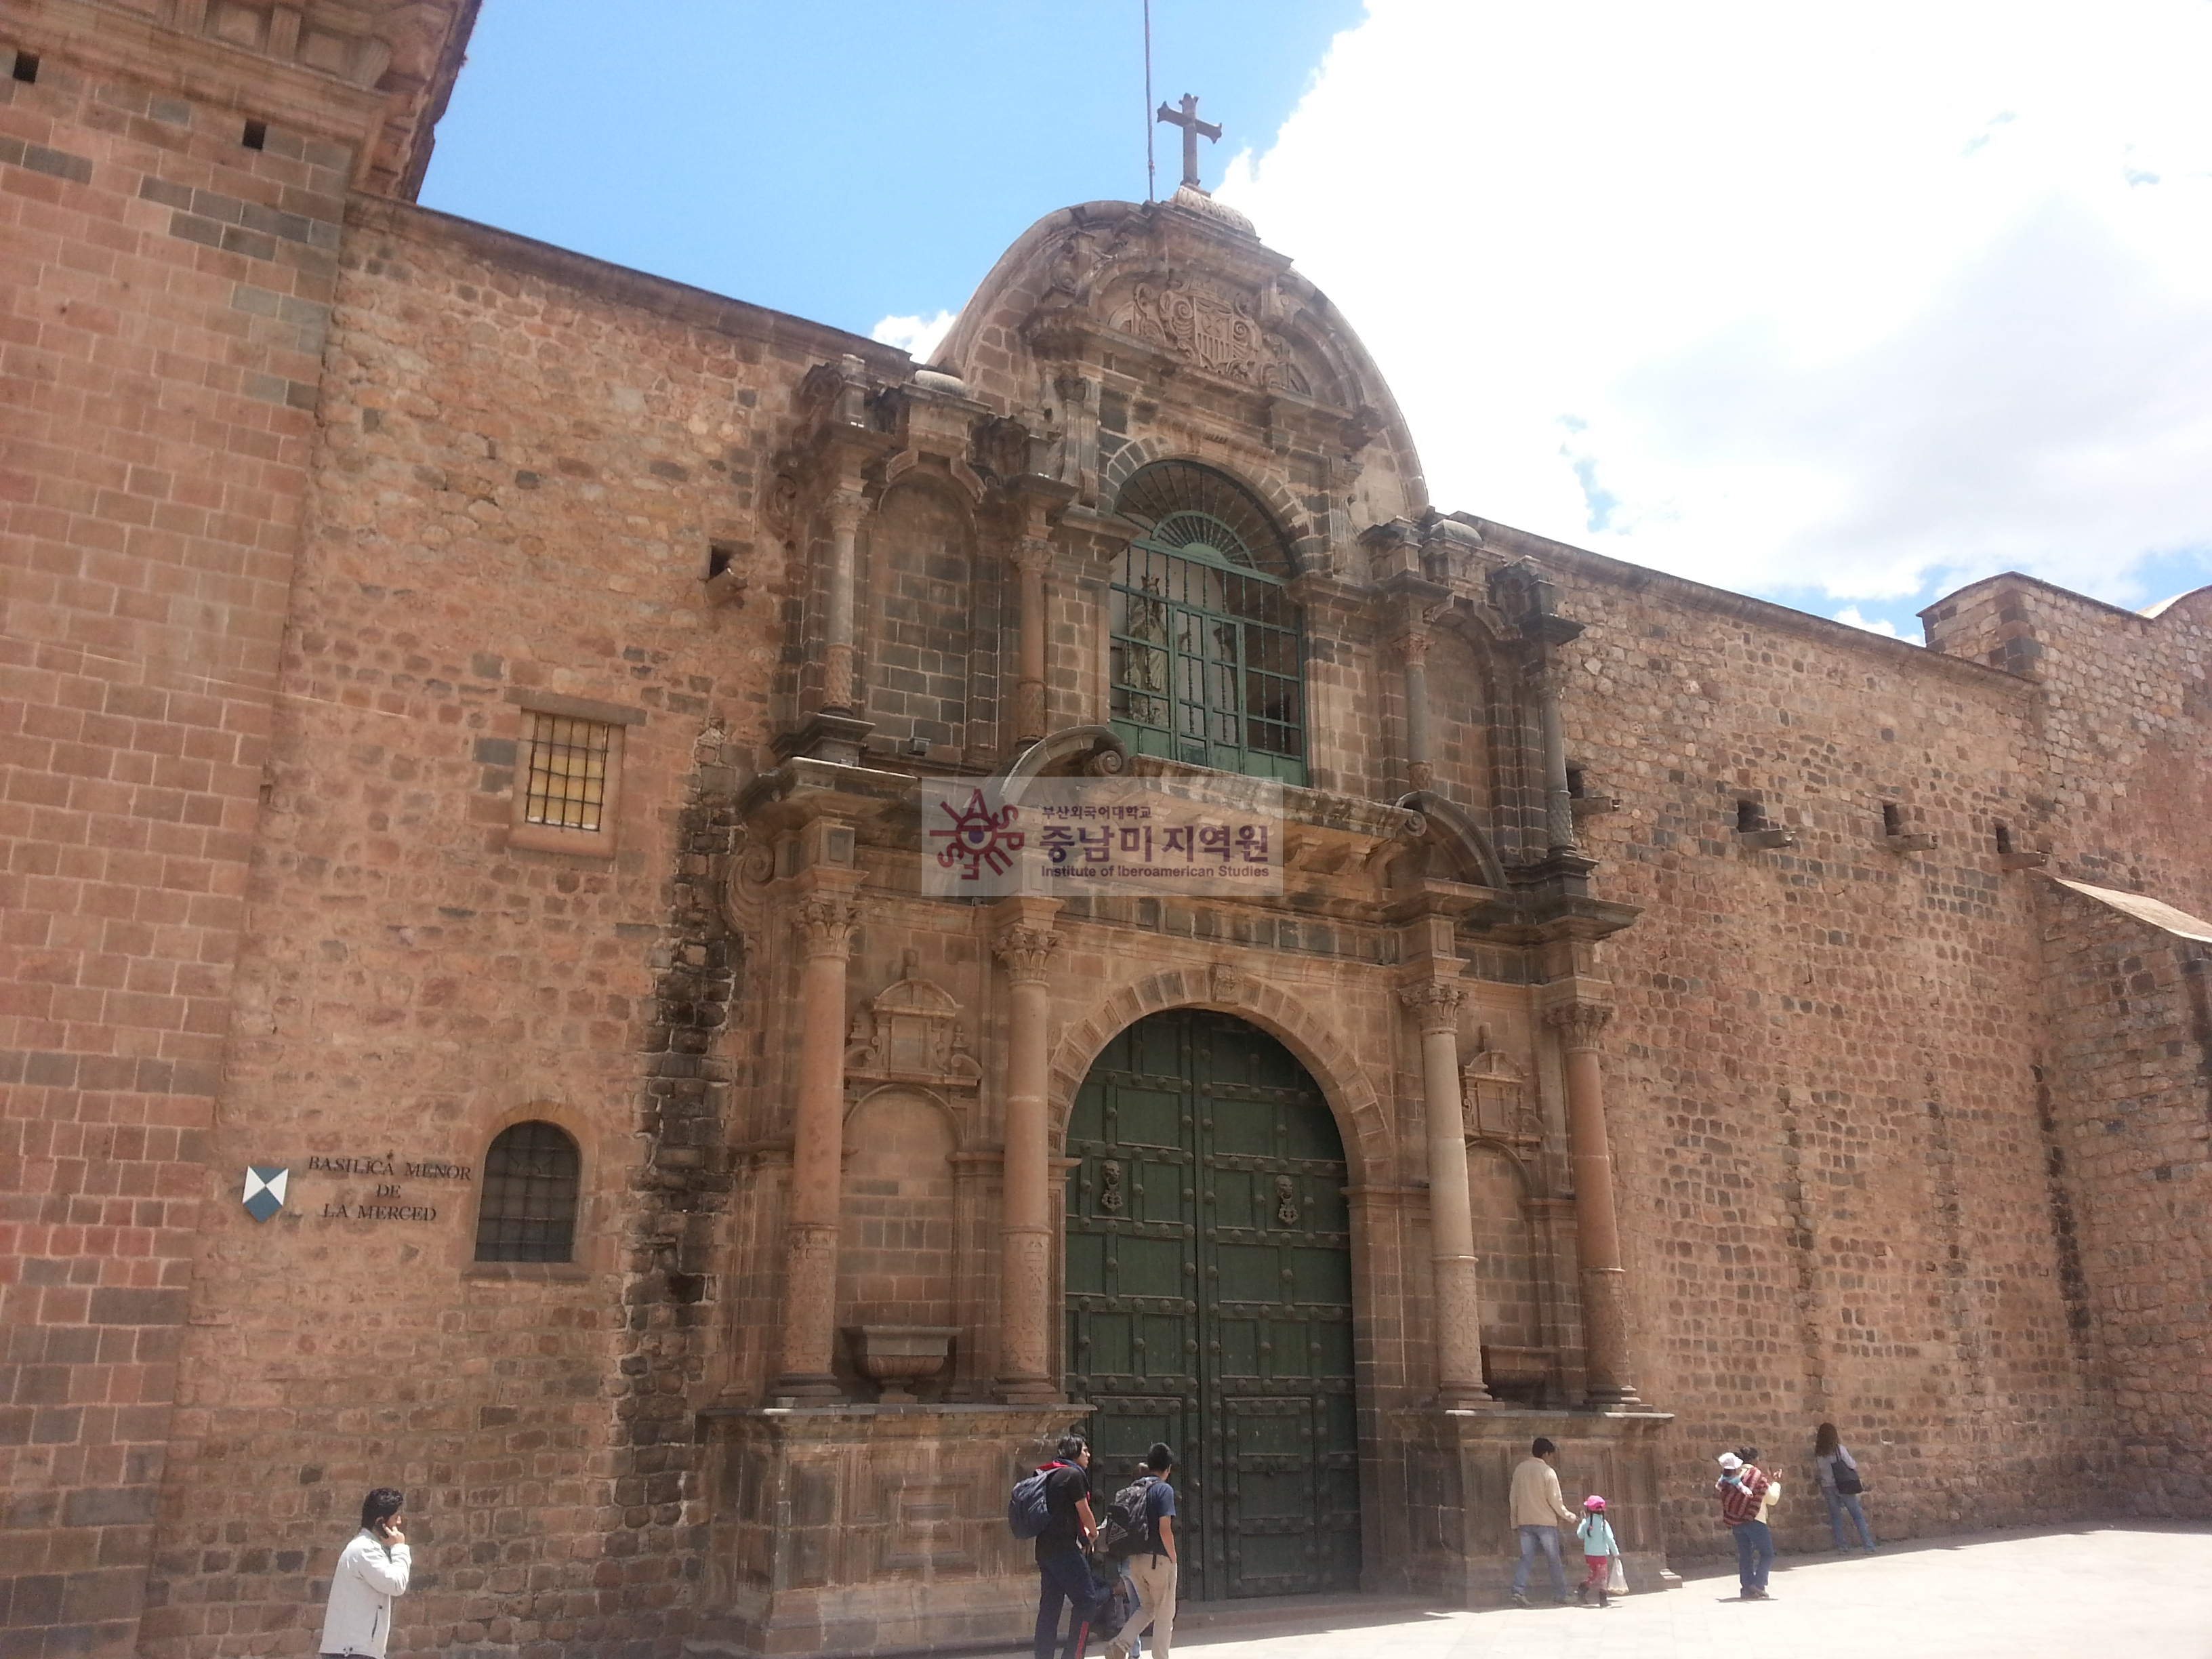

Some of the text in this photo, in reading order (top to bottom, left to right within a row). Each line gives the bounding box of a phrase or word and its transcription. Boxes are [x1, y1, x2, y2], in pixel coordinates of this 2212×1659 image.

[309, 1156, 471, 1181] BASILICA MENOR
[377, 1184, 401, 1199] DE
[323, 1203, 437, 1221] LA MERCED
